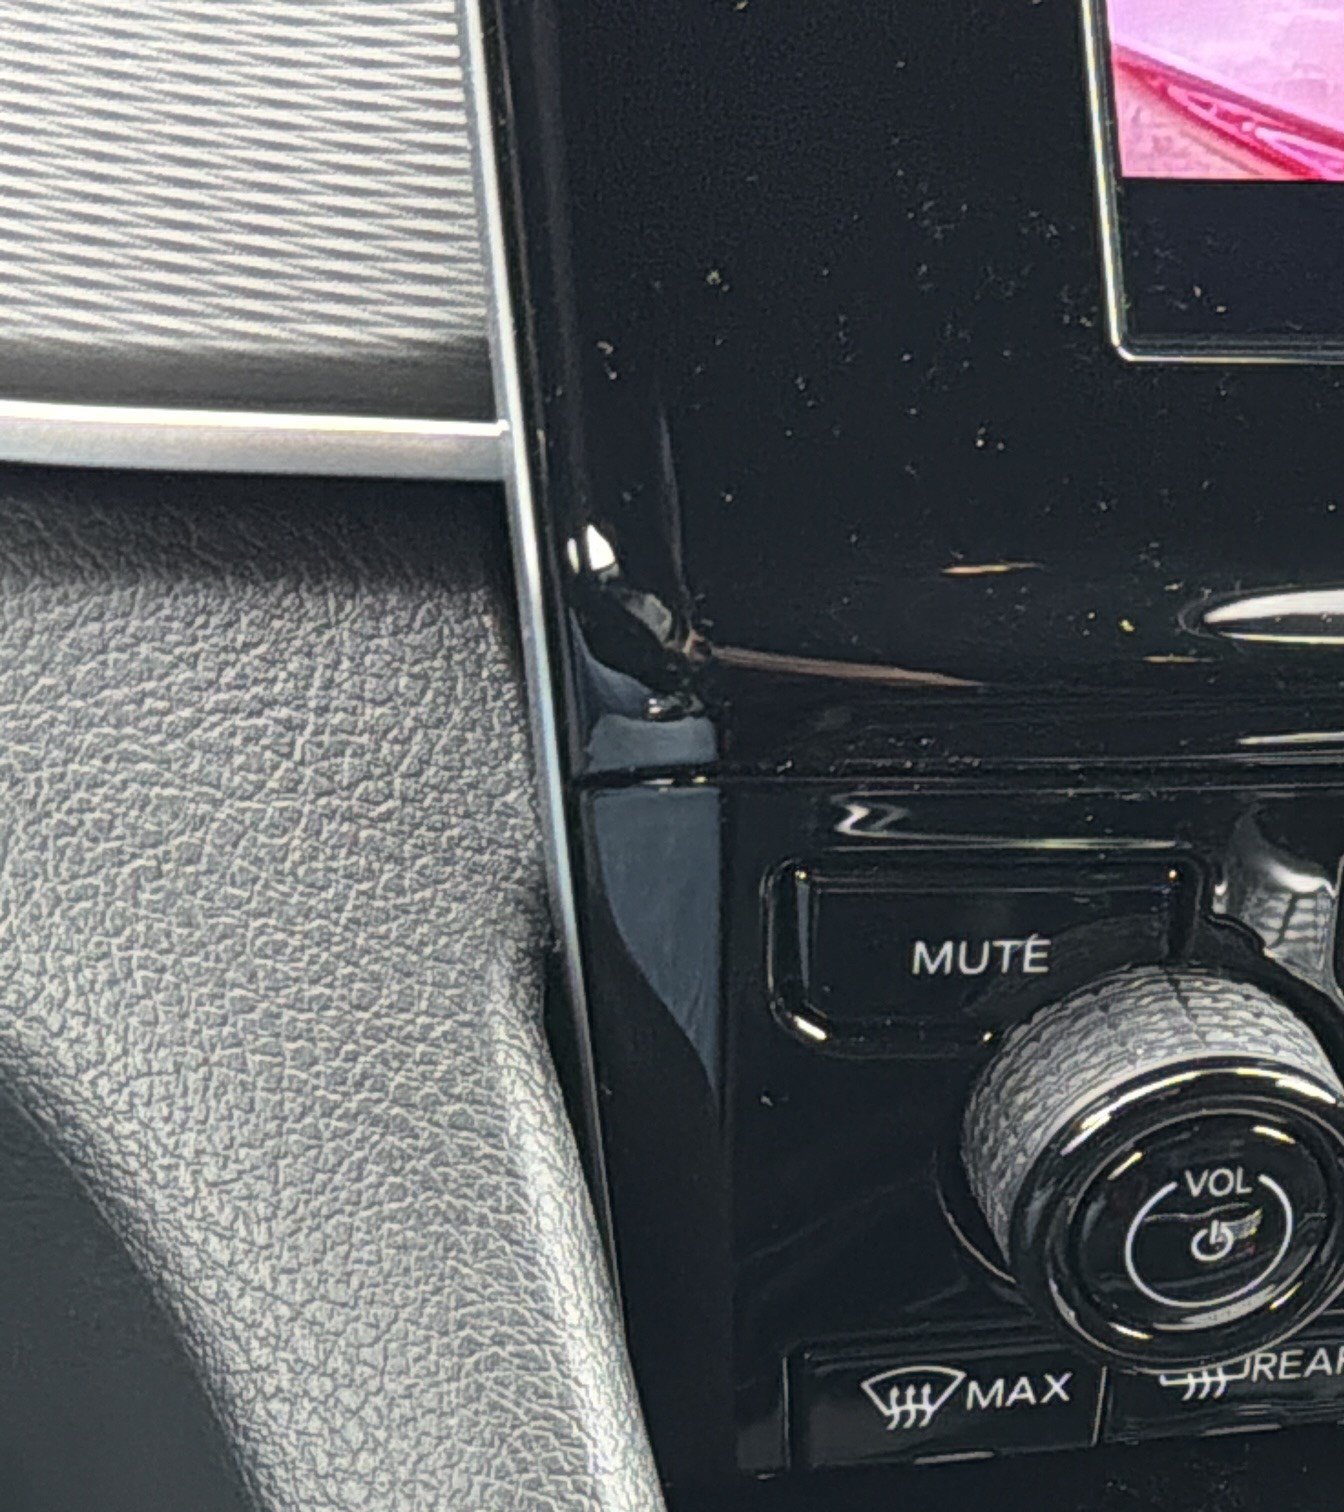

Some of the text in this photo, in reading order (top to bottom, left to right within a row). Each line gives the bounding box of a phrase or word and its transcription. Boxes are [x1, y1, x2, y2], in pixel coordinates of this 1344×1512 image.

[912, 937, 1052, 975] MUTE
[1184, 1168, 1253, 1198] VOL
[966, 1371, 1073, 1412] MAX
